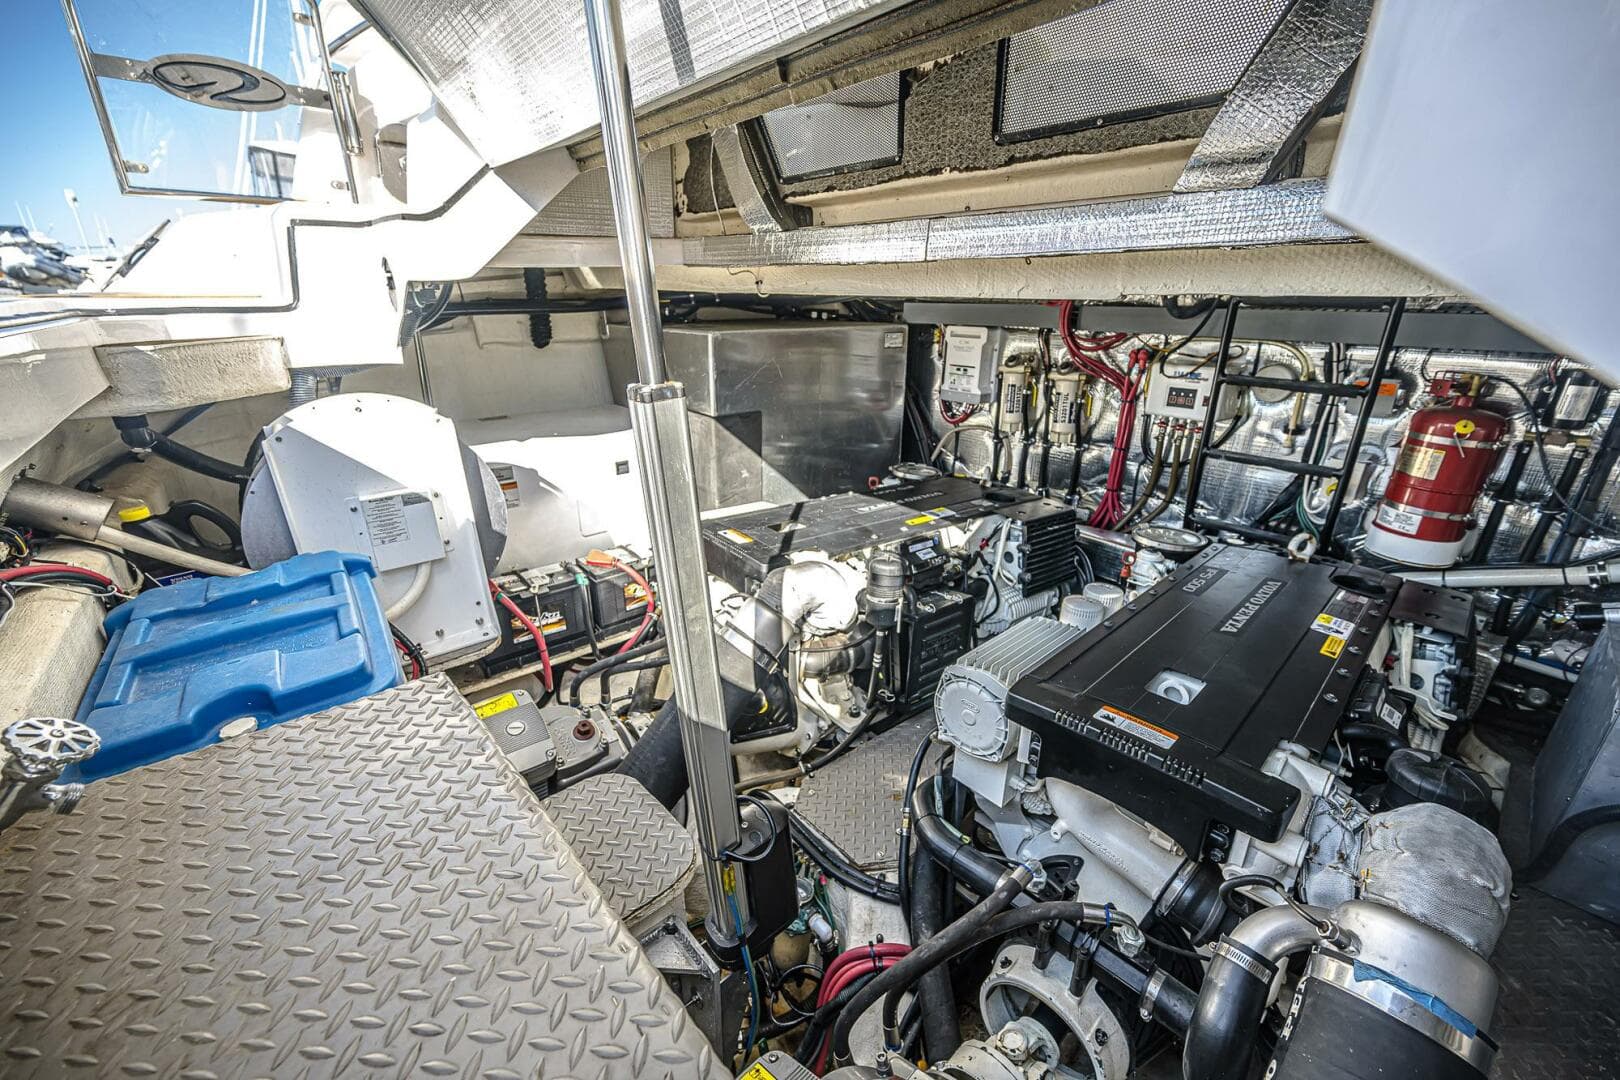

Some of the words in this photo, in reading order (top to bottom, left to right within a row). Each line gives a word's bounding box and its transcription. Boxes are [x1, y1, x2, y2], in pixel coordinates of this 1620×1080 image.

[1182, 578, 1206, 593] 500
[1249, 580, 1283, 606] VOLVO
[1220, 602, 1261, 633] PENTA
